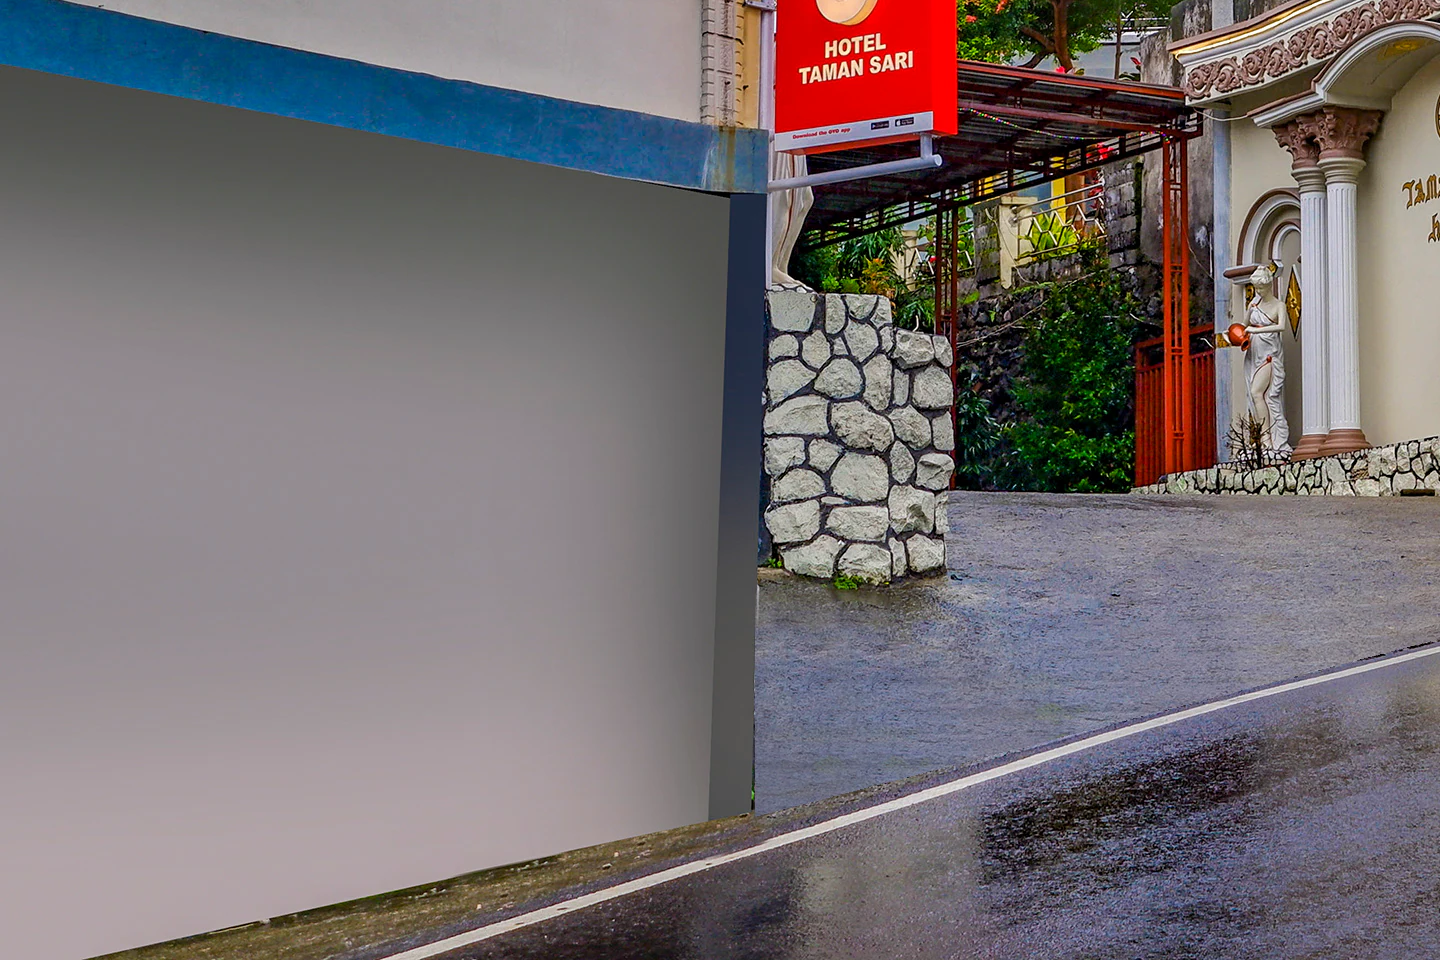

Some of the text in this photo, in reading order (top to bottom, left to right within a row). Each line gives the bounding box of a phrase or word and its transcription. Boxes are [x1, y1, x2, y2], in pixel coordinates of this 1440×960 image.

[825, 33, 886, 59] HOTEL
[799, 50, 913, 85] TAMAN SARI
[792, 131, 817, 139] Download
